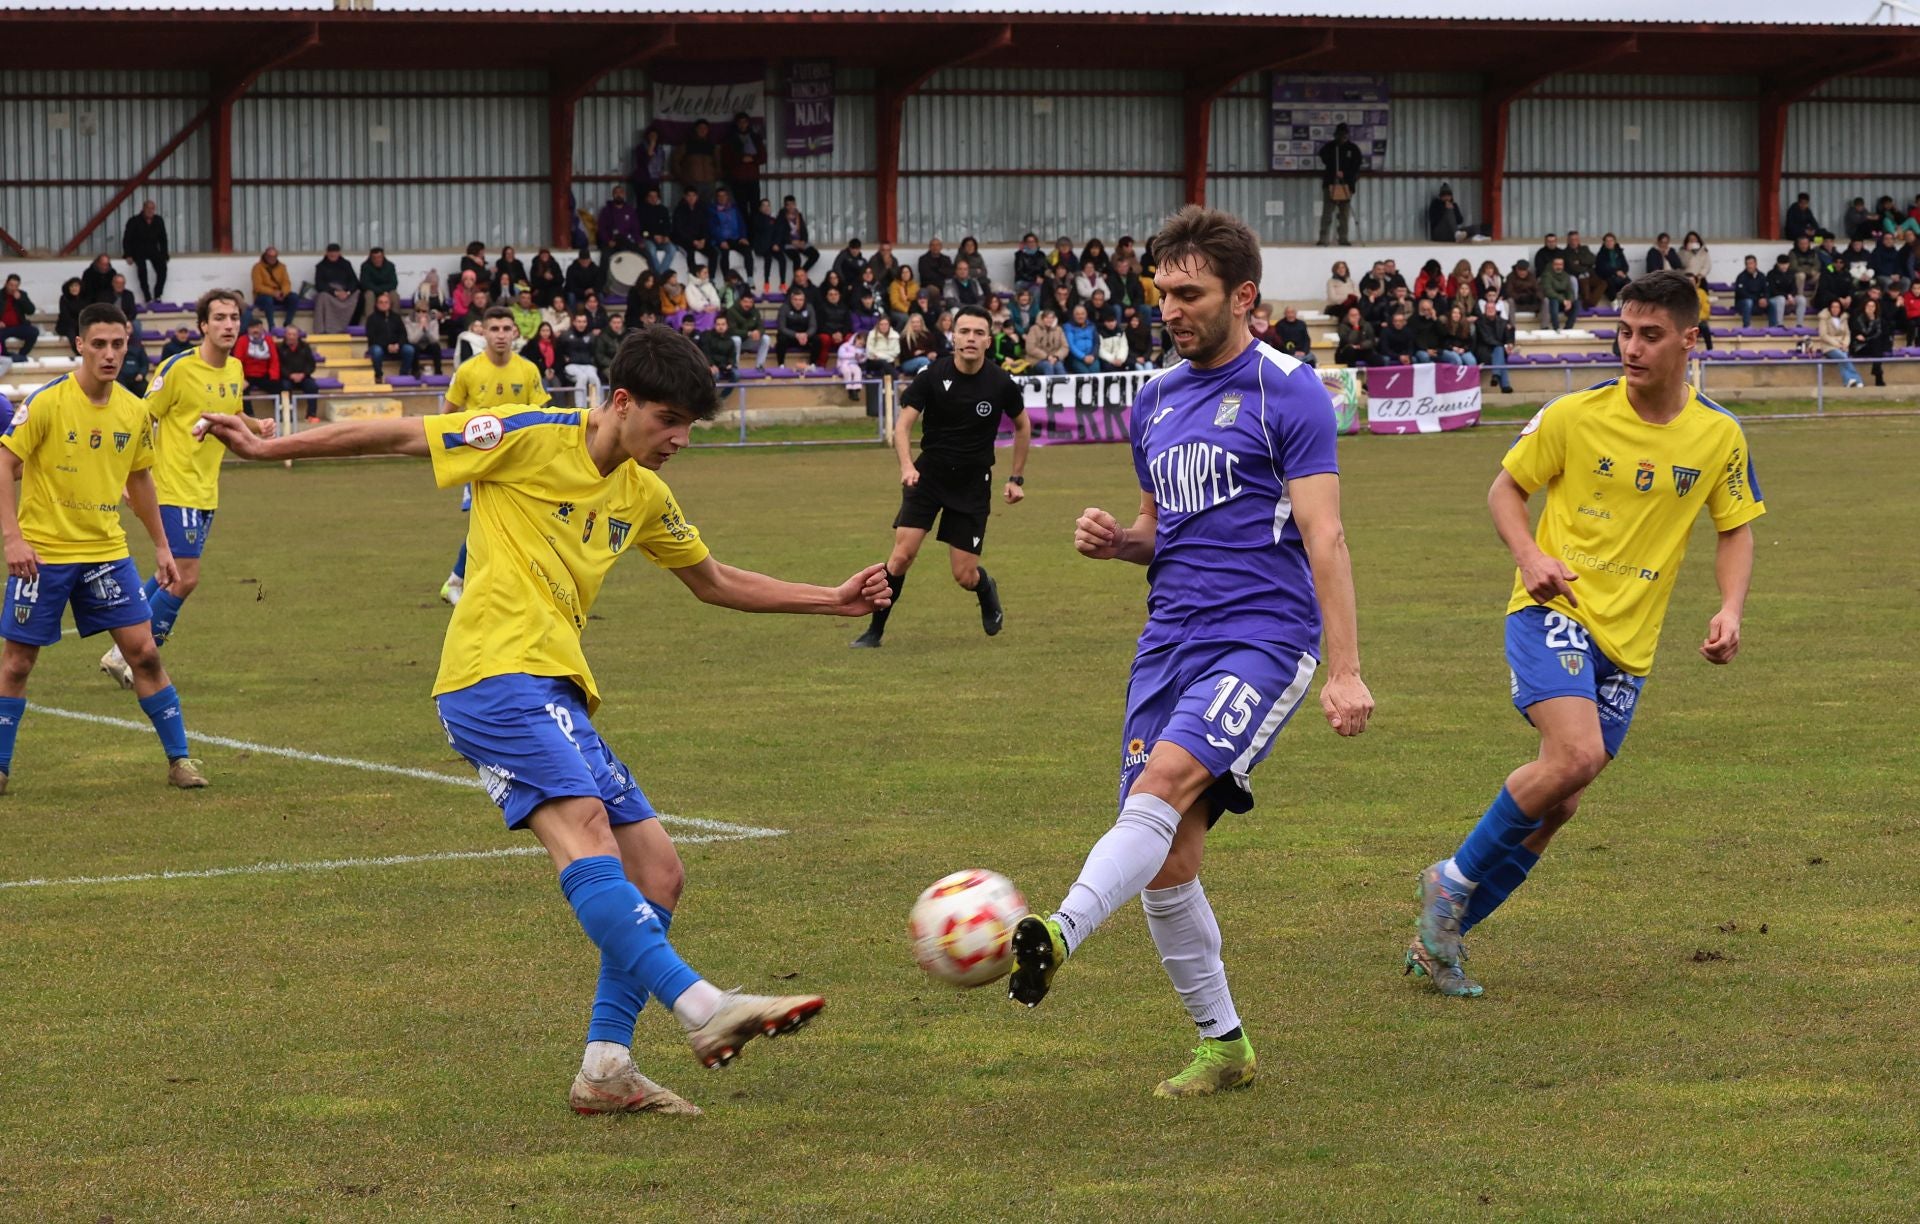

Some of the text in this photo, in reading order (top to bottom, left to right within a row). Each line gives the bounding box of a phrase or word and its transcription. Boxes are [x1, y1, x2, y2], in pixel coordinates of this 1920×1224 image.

[1149, 442, 1242, 513] TECNIPEC
[13, 572, 40, 603] 14
[1203, 674, 1262, 737] 15
